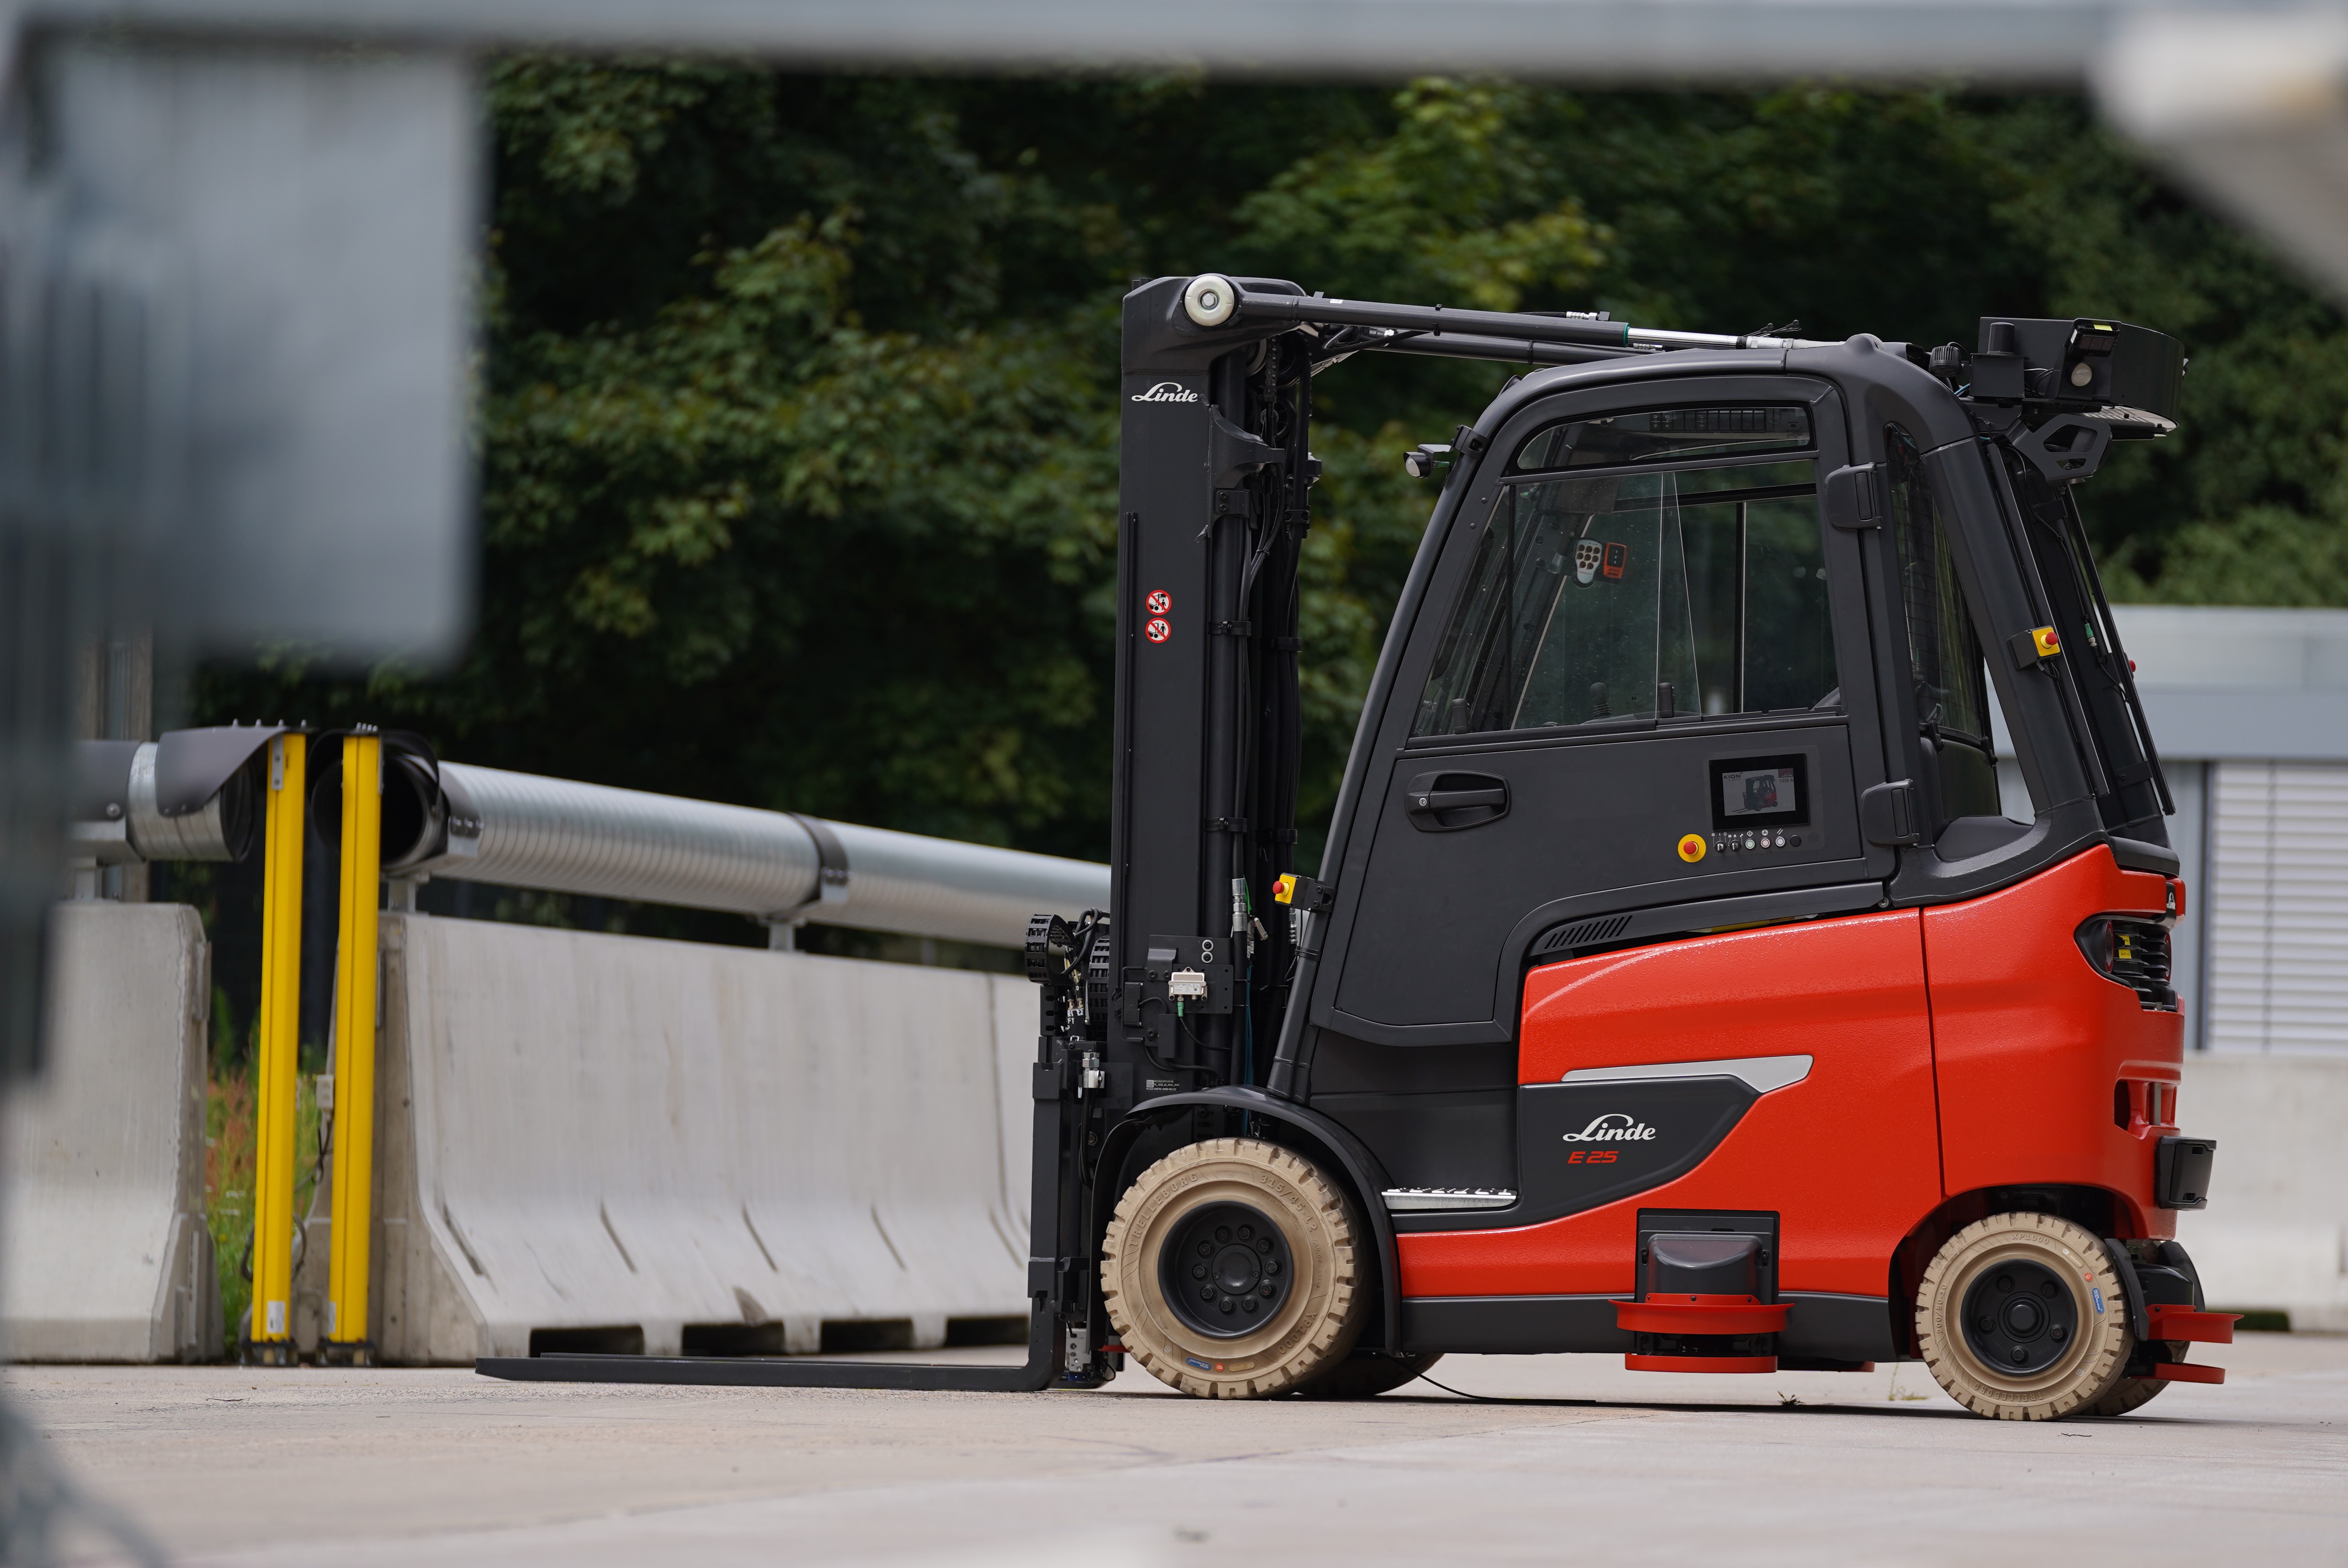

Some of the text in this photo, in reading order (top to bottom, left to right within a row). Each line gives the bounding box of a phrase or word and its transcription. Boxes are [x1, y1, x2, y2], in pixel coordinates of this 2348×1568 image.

[1131, 382, 1198, 402] Linde
[1562, 1114, 1656, 1142] Linde
[1567, 1151, 1619, 1164] E 25
[1129, 1173, 1198, 1246] TRELLEBORG
[1260, 1174, 1318, 1233] 315/45-12
[2012, 1233, 2049, 1245] XP1000
[1935, 1284, 1948, 1334] 200/50-10
[1278, 1309, 1318, 1354] XP1000
[1974, 1382, 2043, 1402] TRELLEBORG
